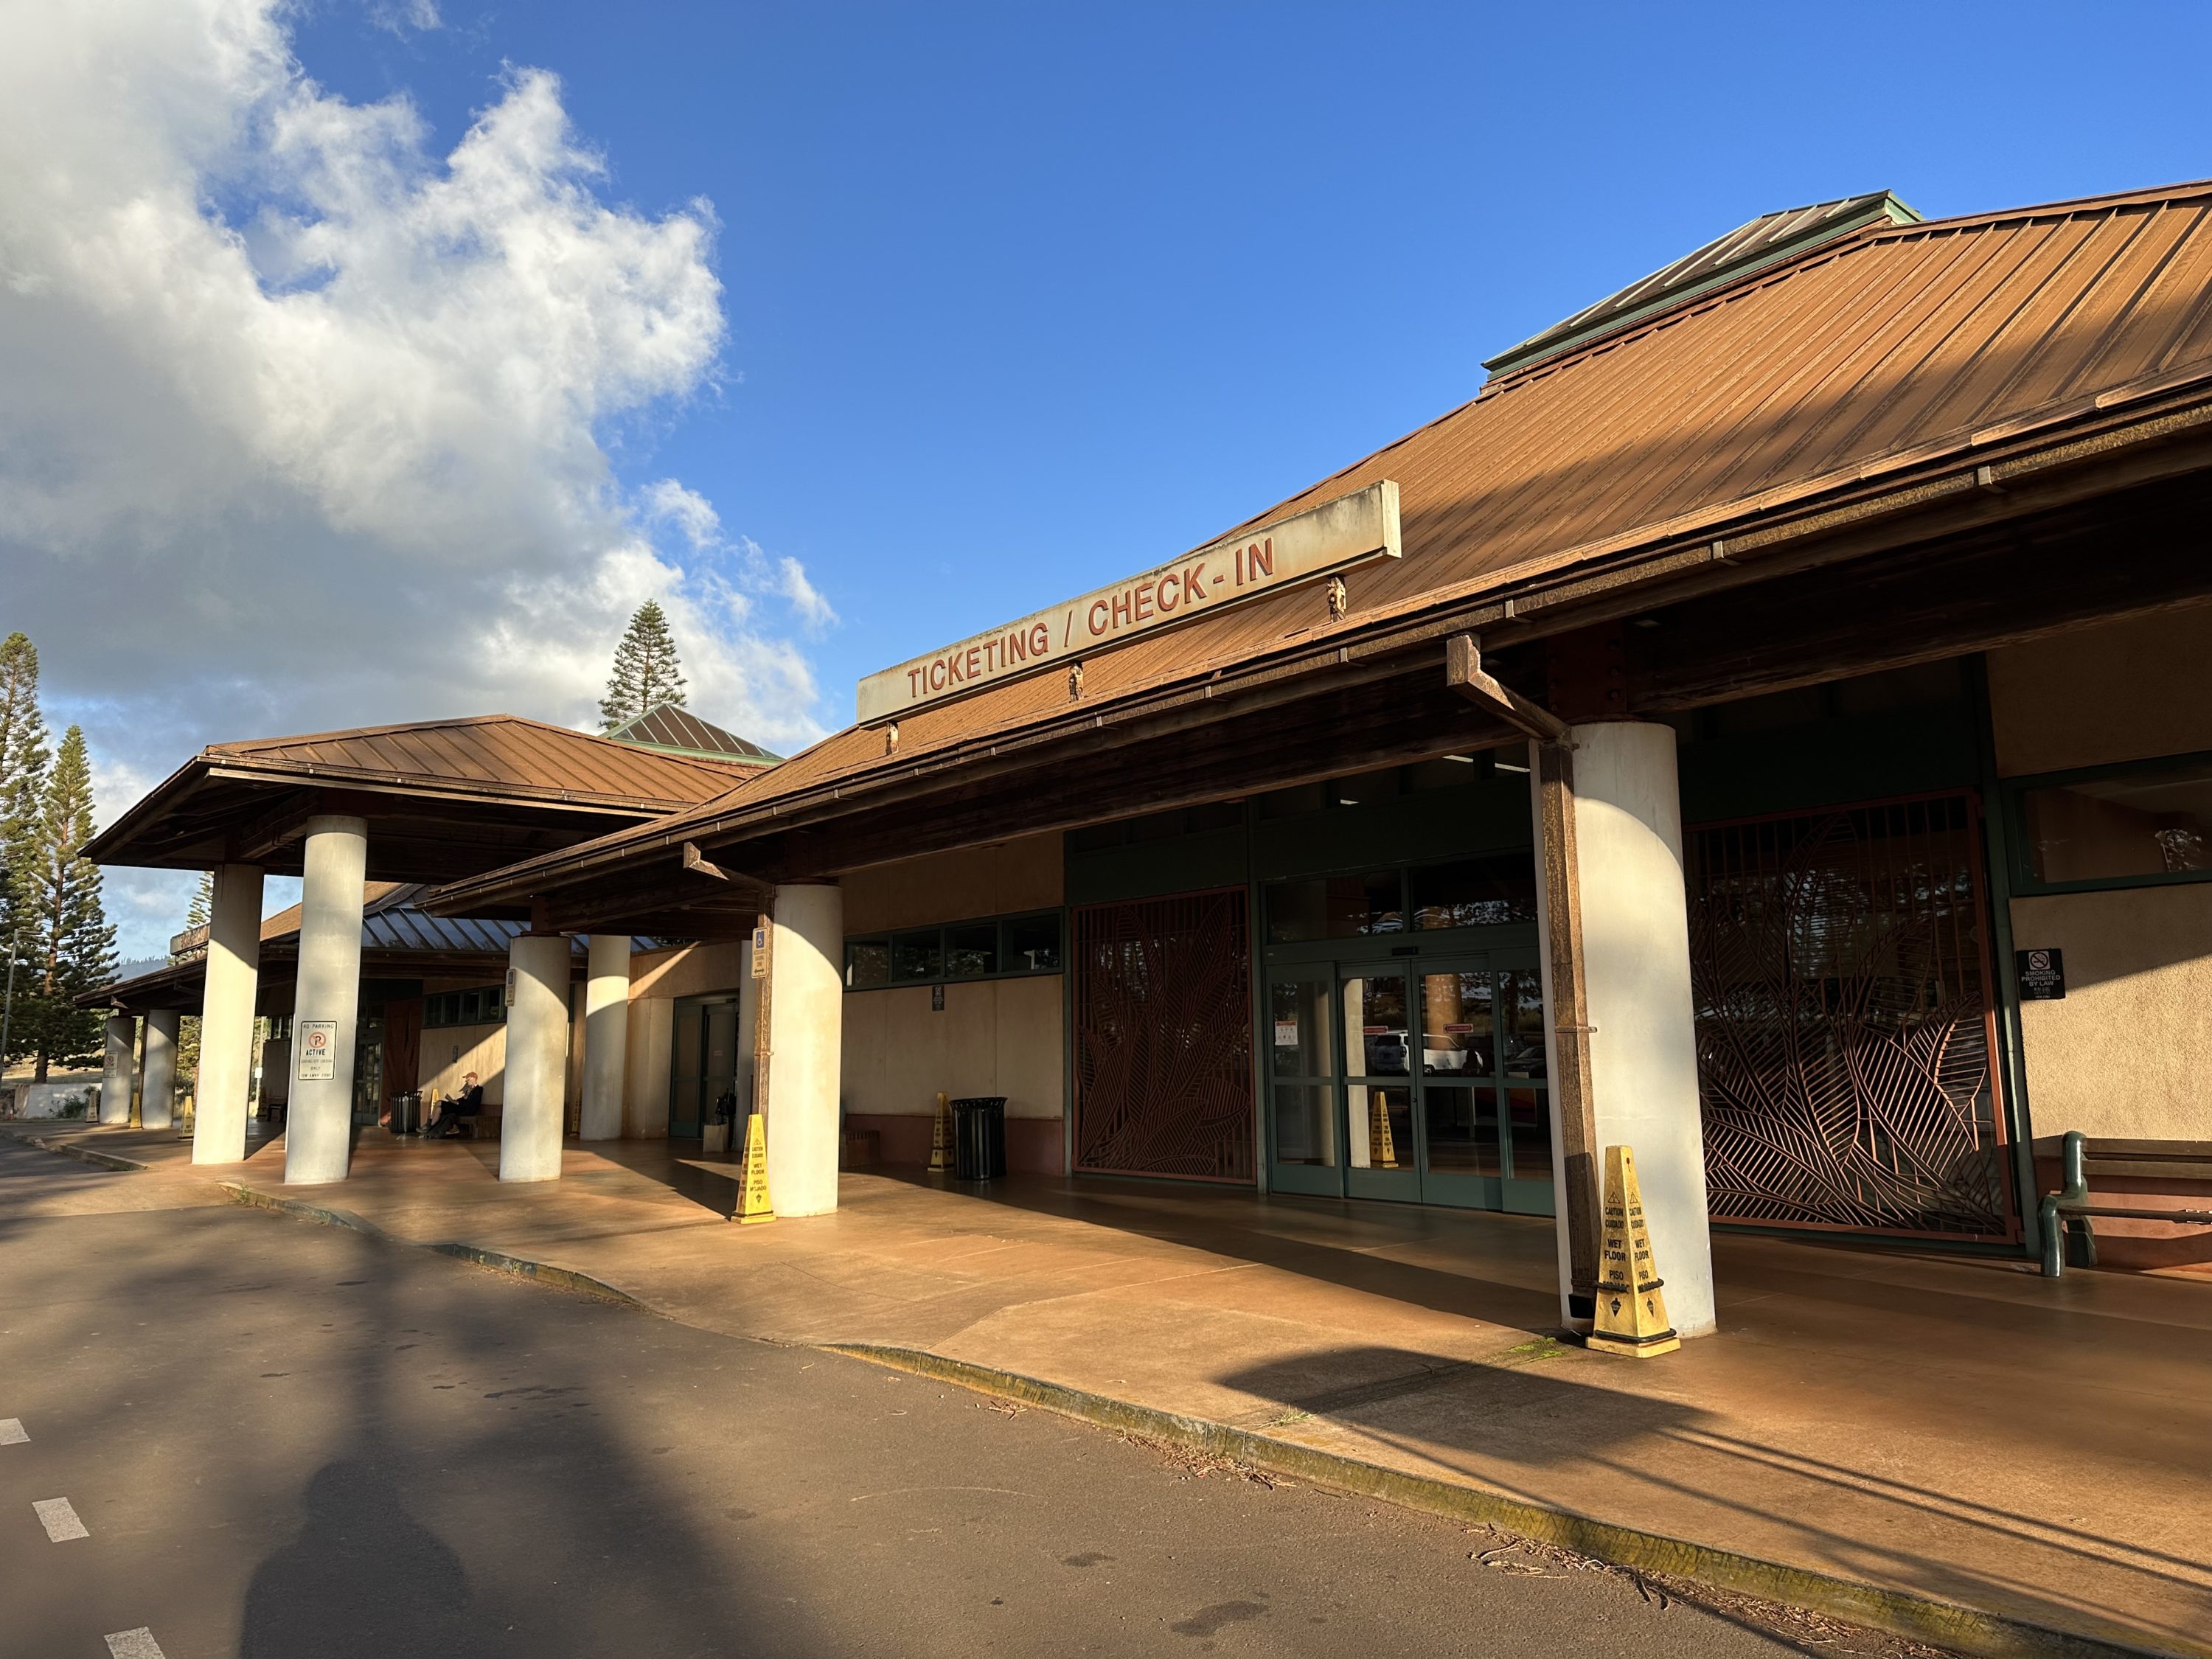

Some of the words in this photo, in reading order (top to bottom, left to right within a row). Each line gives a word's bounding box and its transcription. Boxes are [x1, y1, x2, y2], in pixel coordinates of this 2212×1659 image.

[907, 622, 1049, 698] TICKETING
[1064, 610, 1074, 647] /
[1605, 1206, 1624, 1217] CAUTION
[1629, 1206, 1642, 1217] CAUTION
[1605, 1219, 1624, 1229] CUIDADO
[1630, 1219, 1644, 1229] CUIDADO
[1607, 1238, 1622, 1249] WET
[1635, 1238, 1645, 1249] WET
[1604, 1250, 1627, 1262] FLOOR
[1635, 1250, 1649, 1262] FLOOR
[1609, 1270, 1624, 1281] PISO
[1638, 1270, 1649, 1281] PISO
